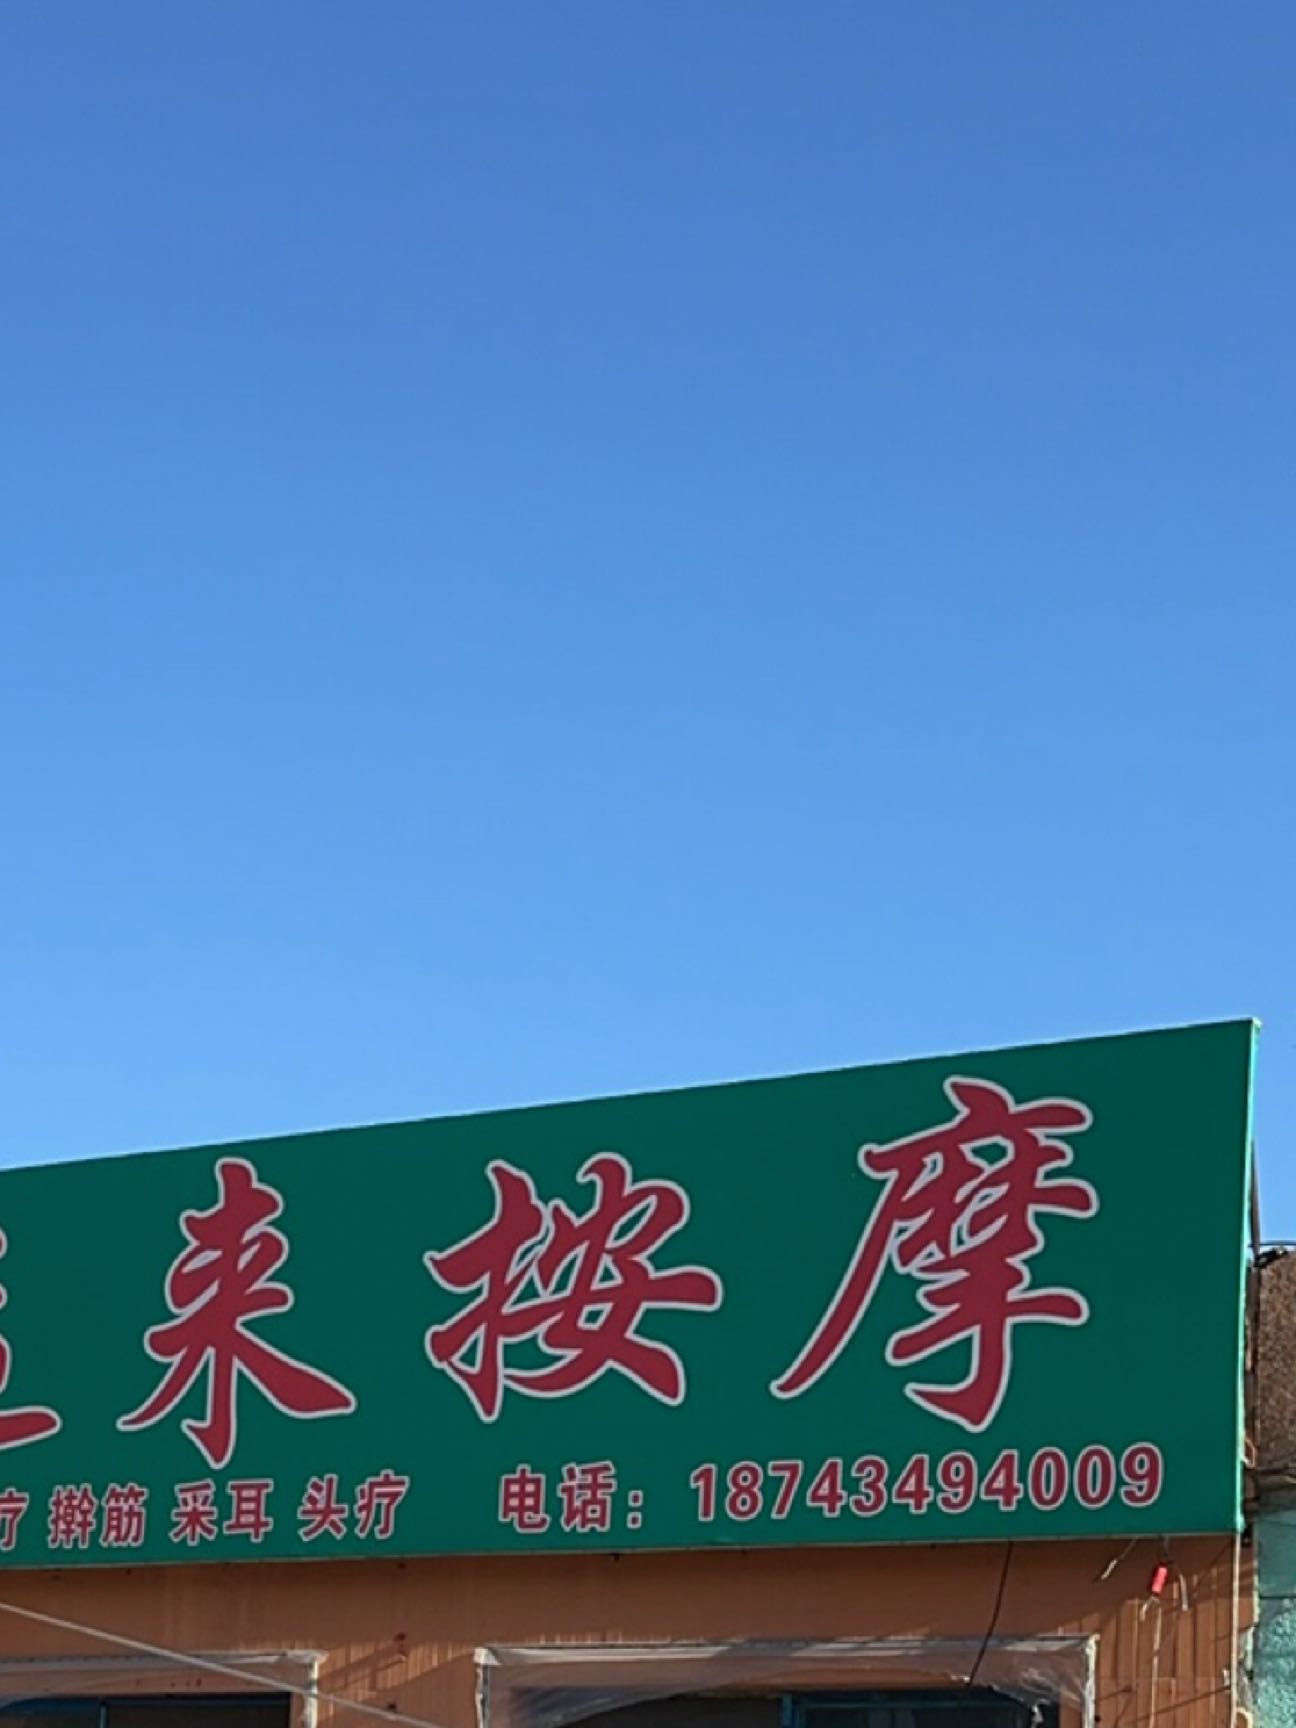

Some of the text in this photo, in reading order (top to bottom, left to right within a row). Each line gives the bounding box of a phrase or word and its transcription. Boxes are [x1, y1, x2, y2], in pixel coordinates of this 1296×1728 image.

[169, 1477, 275, 1544] 采耳
[297, 1469, 410, 1541] 头疗
[689, 1442, 1165, 1522] 18743494009
